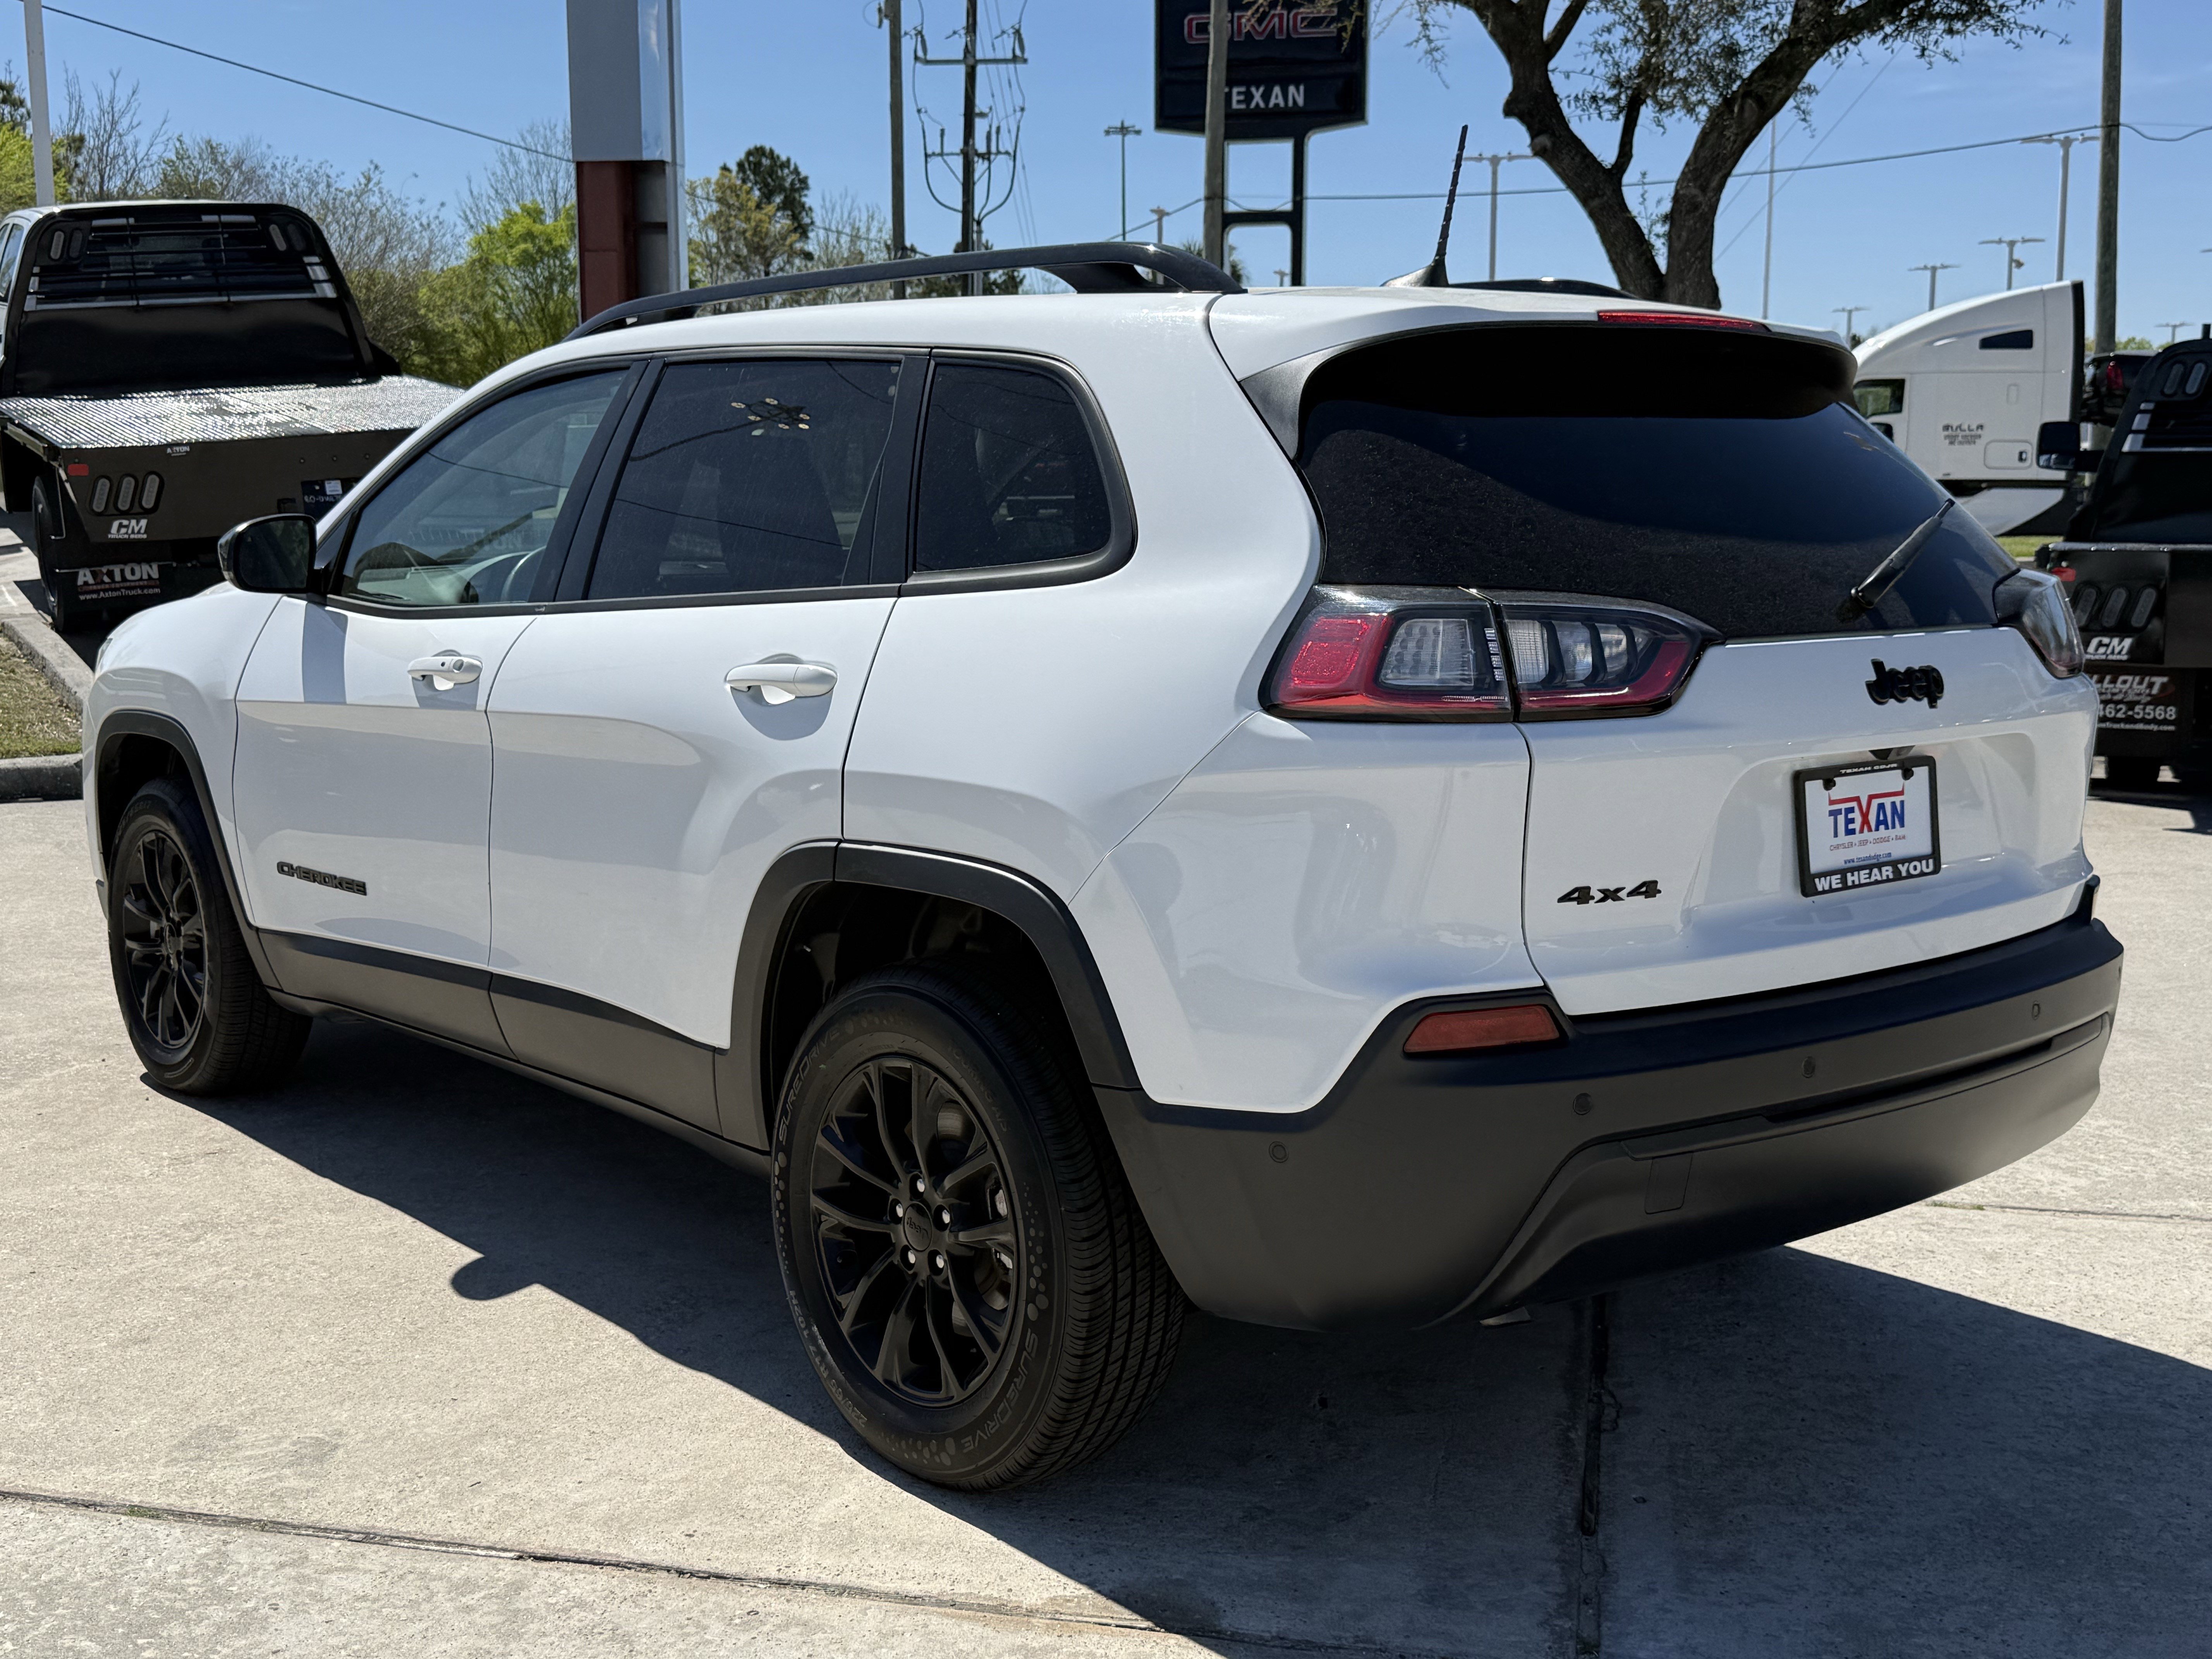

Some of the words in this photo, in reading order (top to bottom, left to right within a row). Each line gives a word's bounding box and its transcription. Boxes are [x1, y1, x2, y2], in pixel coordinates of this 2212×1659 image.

[1184, 7, 1337, 44] GMC
[1224, 84, 1305, 109] EXAN
[111, 519, 148, 534] CM
[77, 562, 159, 586] AXTON
[79, 587, 161, 600] www.AxtonTruck.com
[2087, 637, 2133, 654] CM
[1865, 658, 1944, 709] Jeep
[2091, 674, 2169, 695] LLOUT
[1828, 790, 1905, 838] TEXAN
[277, 861, 367, 896] CHEROKEE
[1815, 874, 1842, 891] WE
[1846, 866, 1894, 886] HEAR
[1898, 859, 1934, 877] YOU
[1557, 880, 1662, 905] 4x4
